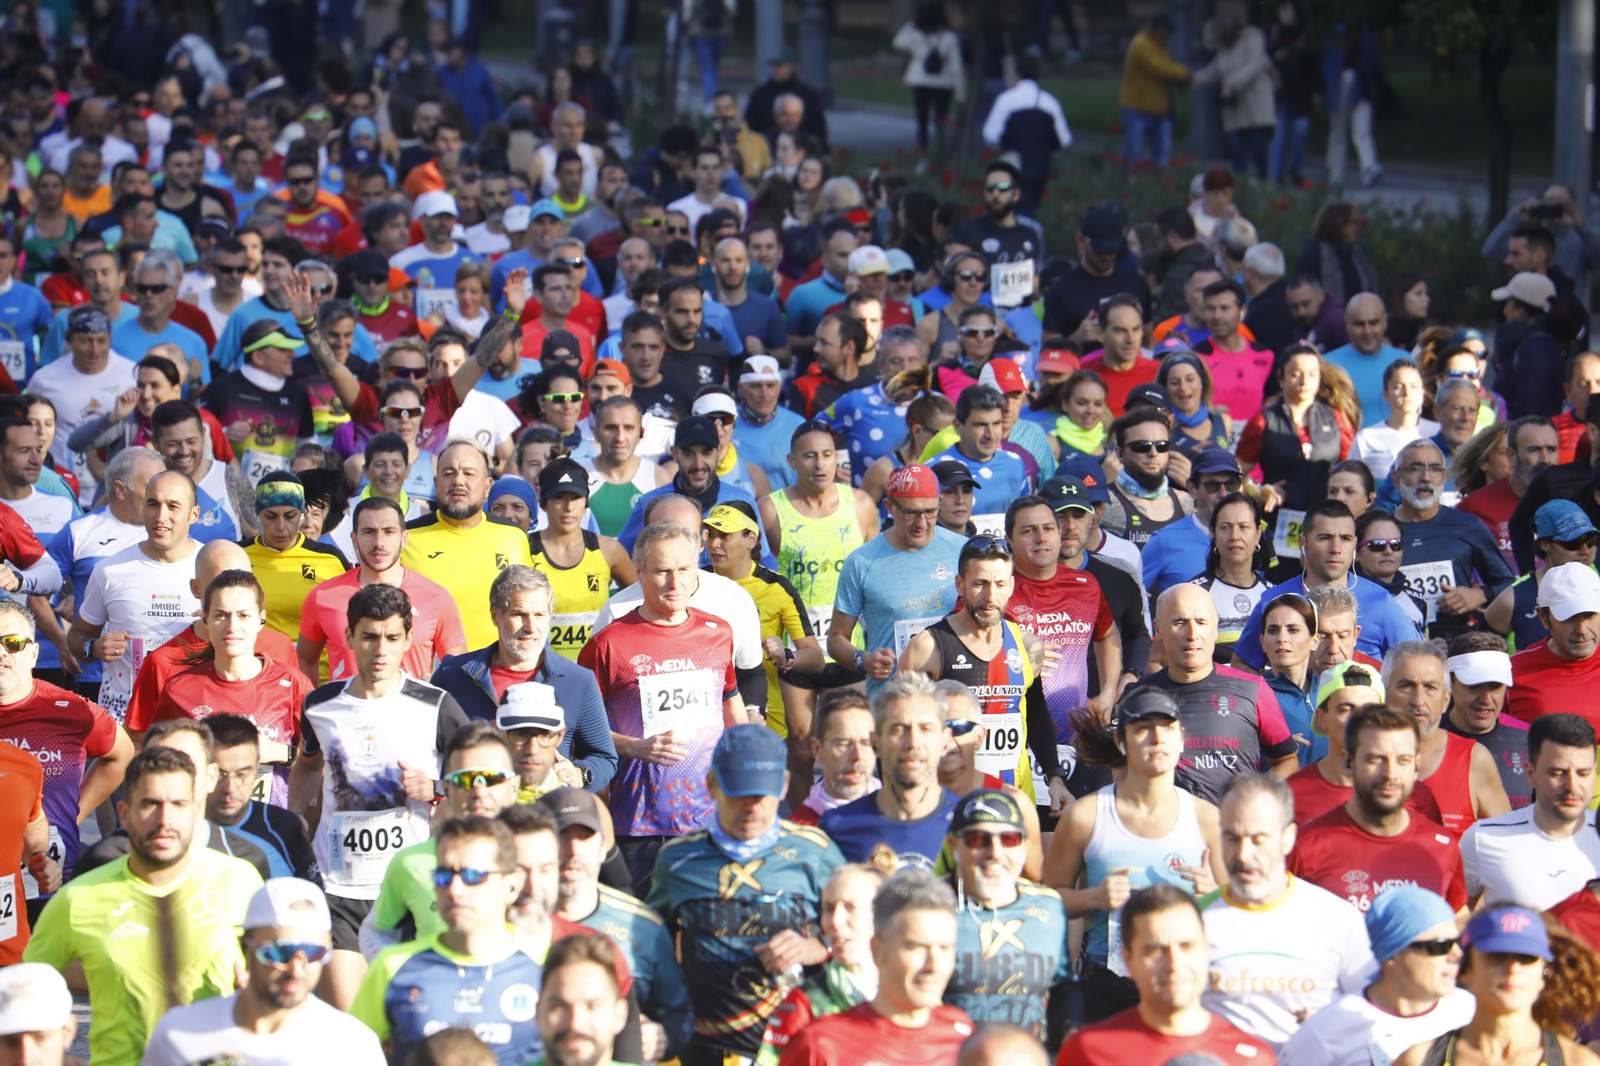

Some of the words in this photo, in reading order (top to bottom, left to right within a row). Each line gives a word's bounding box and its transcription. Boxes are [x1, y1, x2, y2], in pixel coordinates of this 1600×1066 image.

[1001, 271, 1031, 285] 4196
[0, 354, 22, 367] 75
[1405, 566, 1431, 574] IMDECO
[152, 603, 181, 611] IMIBIC
[1036, 612, 1072, 624] MEDIA
[1037, 619, 1092, 636] MARATÓN
[654, 659, 697, 672] MEDIA
[979, 686, 991, 695] LA
[993, 686, 1023, 696] UNION
[1186, 736, 1240, 749] ATLETISMO
[1195, 750, 1238, 770] NÚÑEZ
[352, 815, 382, 823] IMDECO
[343, 825, 404, 853] 4003
[1208, 969, 1317, 994] Refresco
